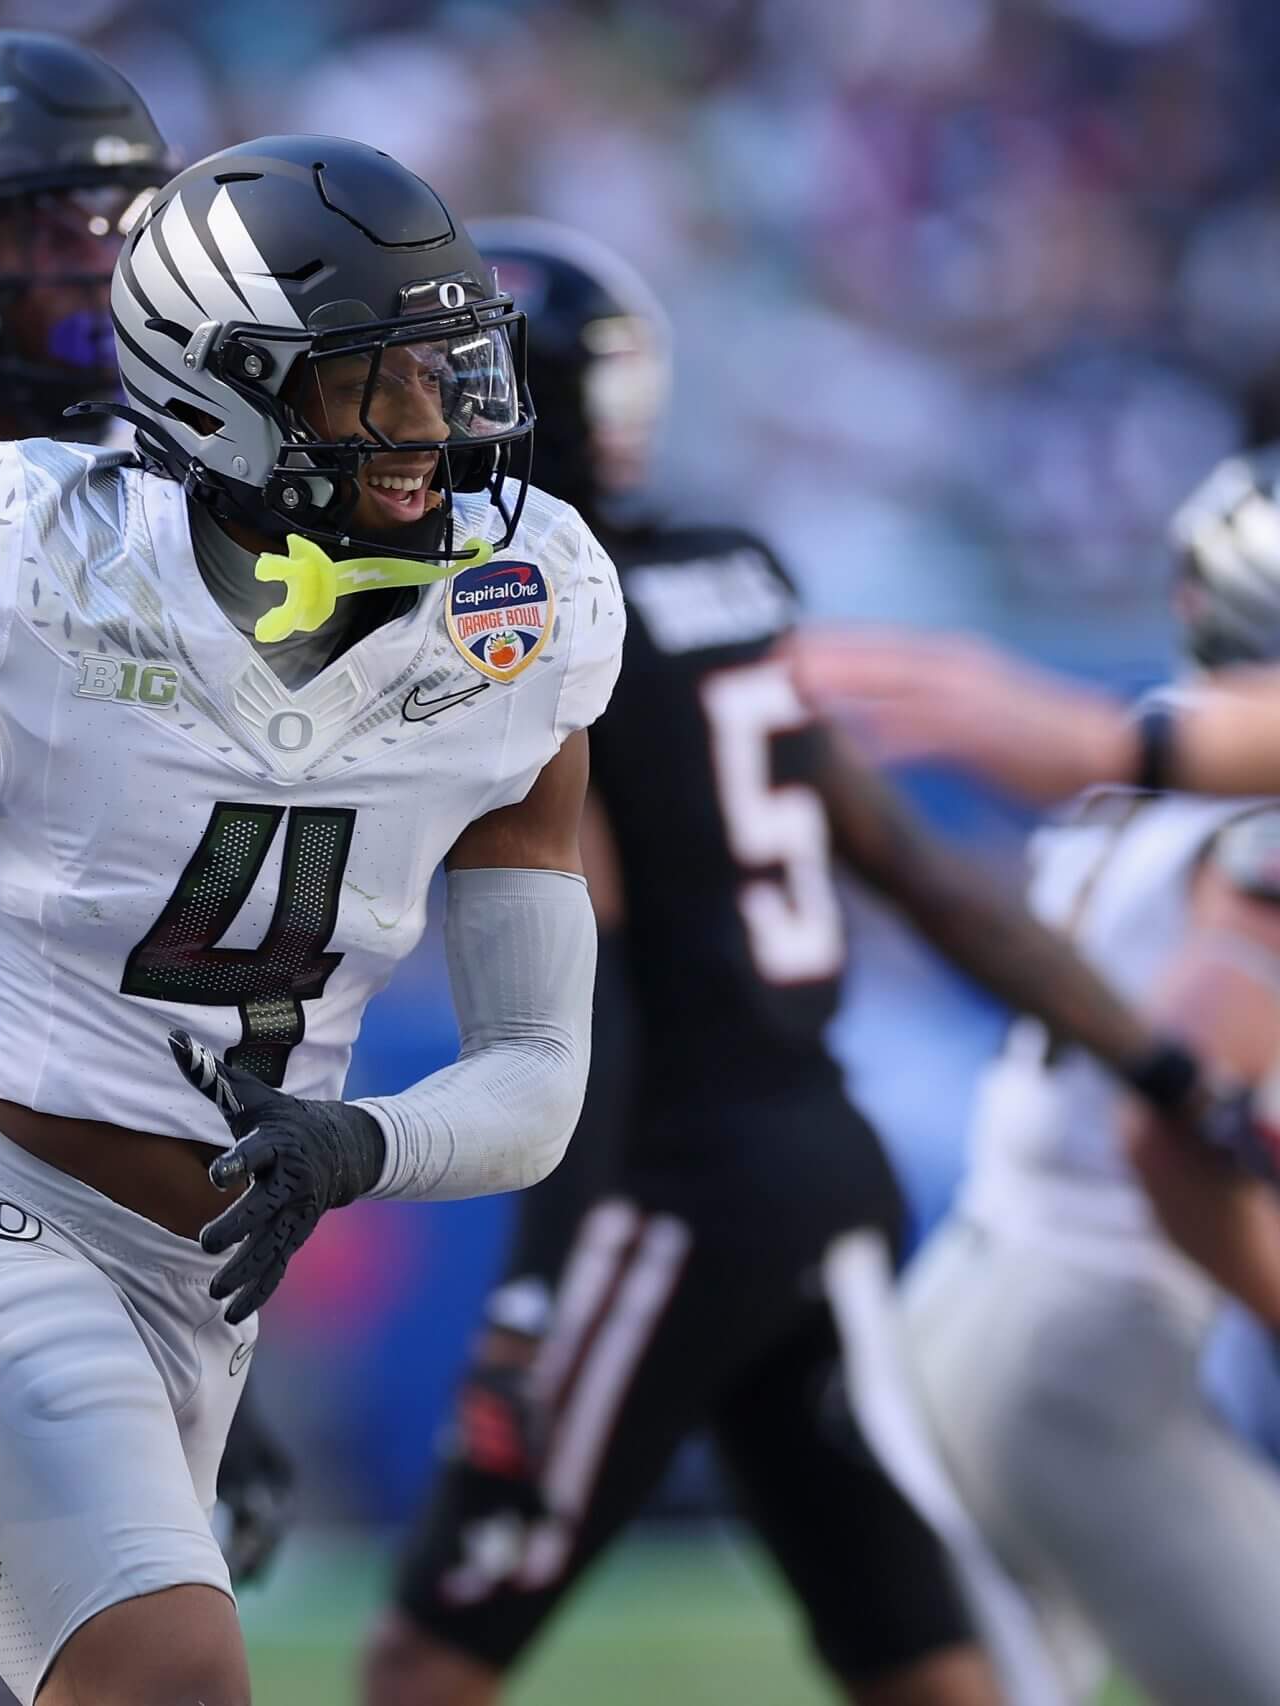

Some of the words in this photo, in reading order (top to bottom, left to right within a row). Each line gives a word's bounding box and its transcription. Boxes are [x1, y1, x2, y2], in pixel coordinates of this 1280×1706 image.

[439, 283, 465, 309] O
[457, 611, 504, 641] ORANGE
[505, 605, 545, 629] BOWL
[267, 711, 314, 751] O
[700, 658, 846, 986] 5
[120, 801, 358, 1088] 4
